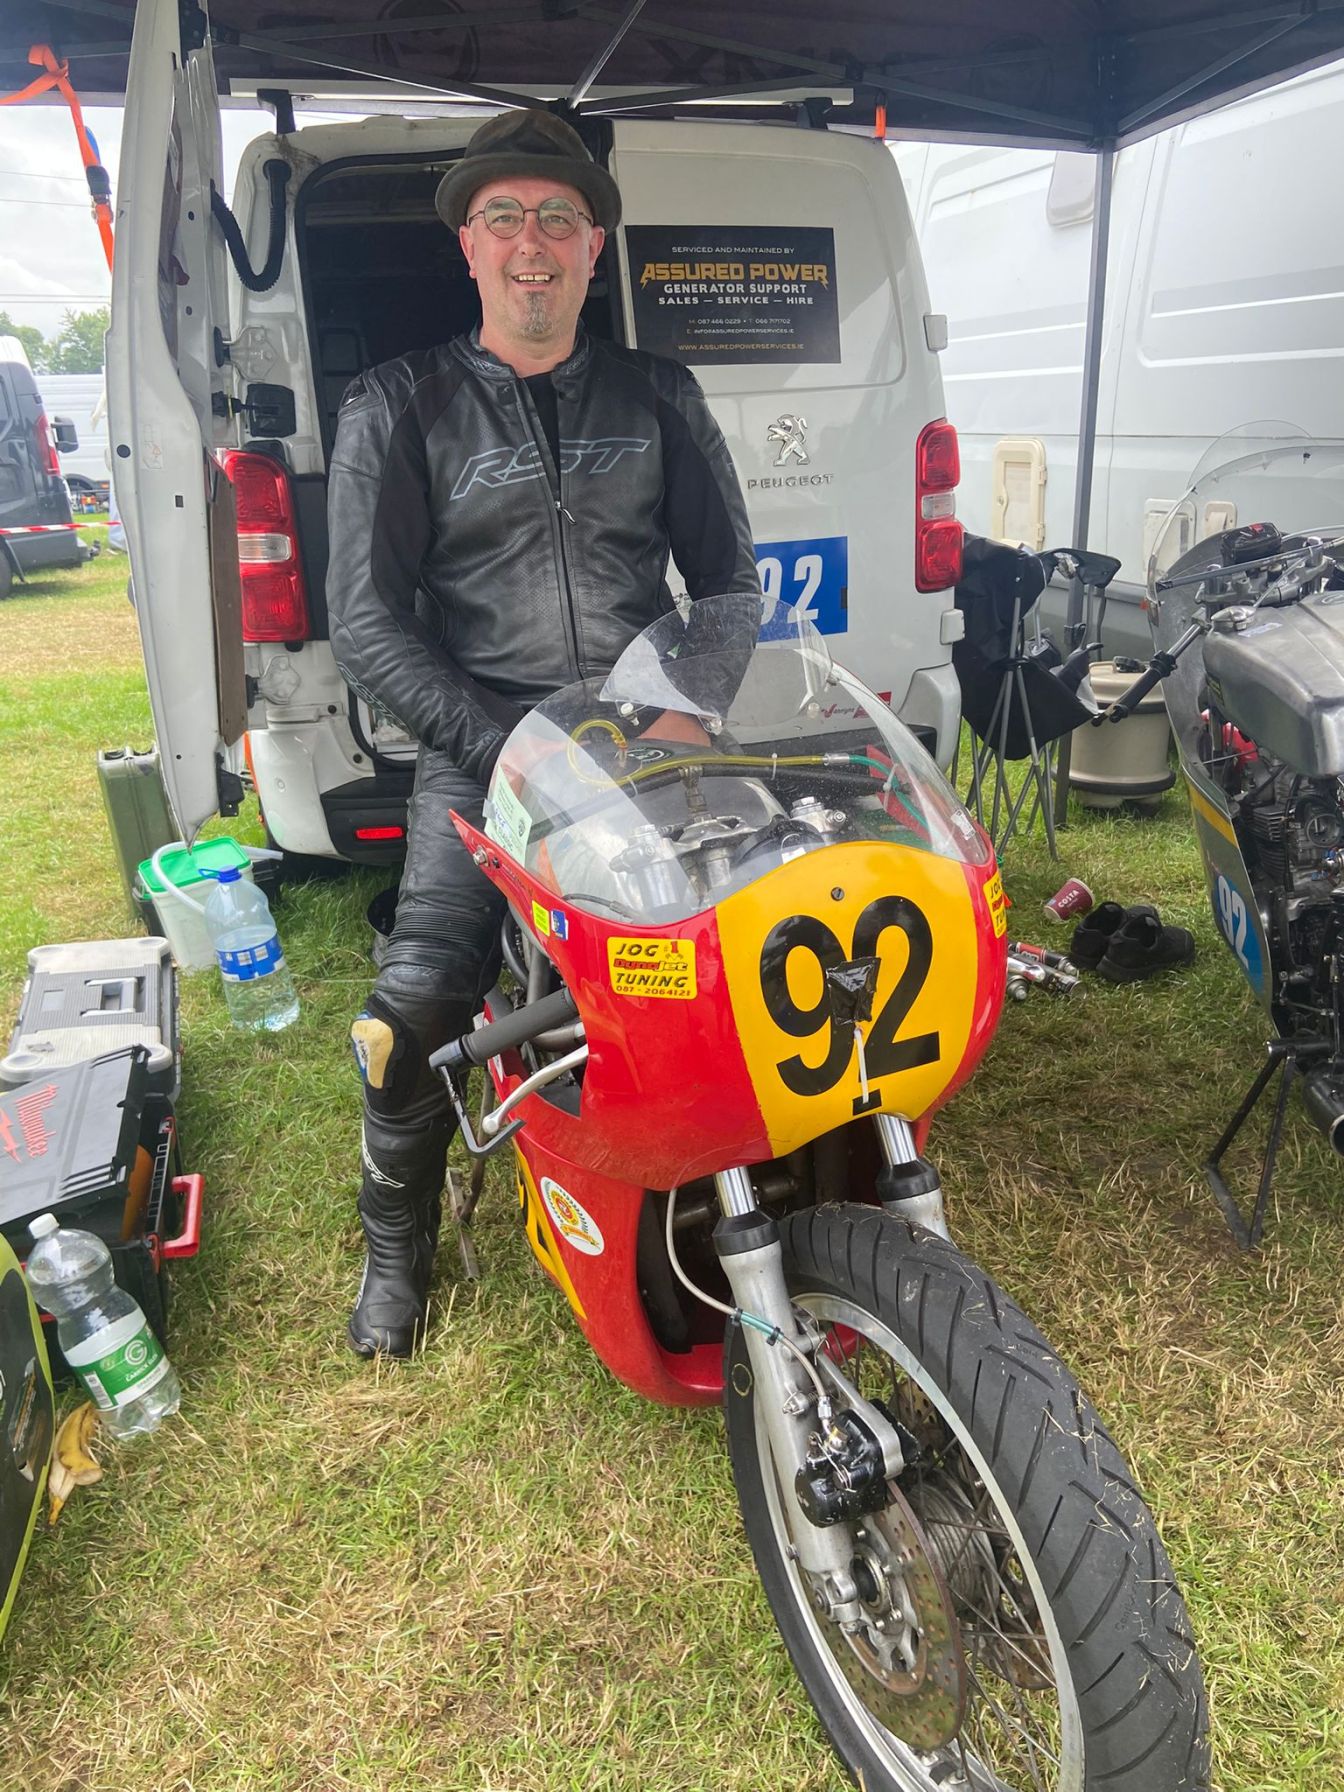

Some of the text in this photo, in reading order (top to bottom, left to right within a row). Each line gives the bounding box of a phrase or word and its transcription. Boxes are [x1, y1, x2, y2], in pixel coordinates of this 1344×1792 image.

[641, 263, 828, 289] ASSURED POWER
[664, 284, 807, 294] GENERATOR SUPPORT
[658, 296, 699, 305] SALES
[717, 296, 769, 304] SERVICE
[786, 297, 814, 305] HIRE
[450, 438, 652, 501] RST
[747, 473, 834, 489] PEUGEOT
[1058, 889, 1080, 908] COSTA
[1218, 875, 1249, 970] 92
[616, 943, 660, 957] JOG
[616, 972, 689, 988] TUNING
[616, 985, 635, 993] 087
[759, 895, 941, 1097] 92
